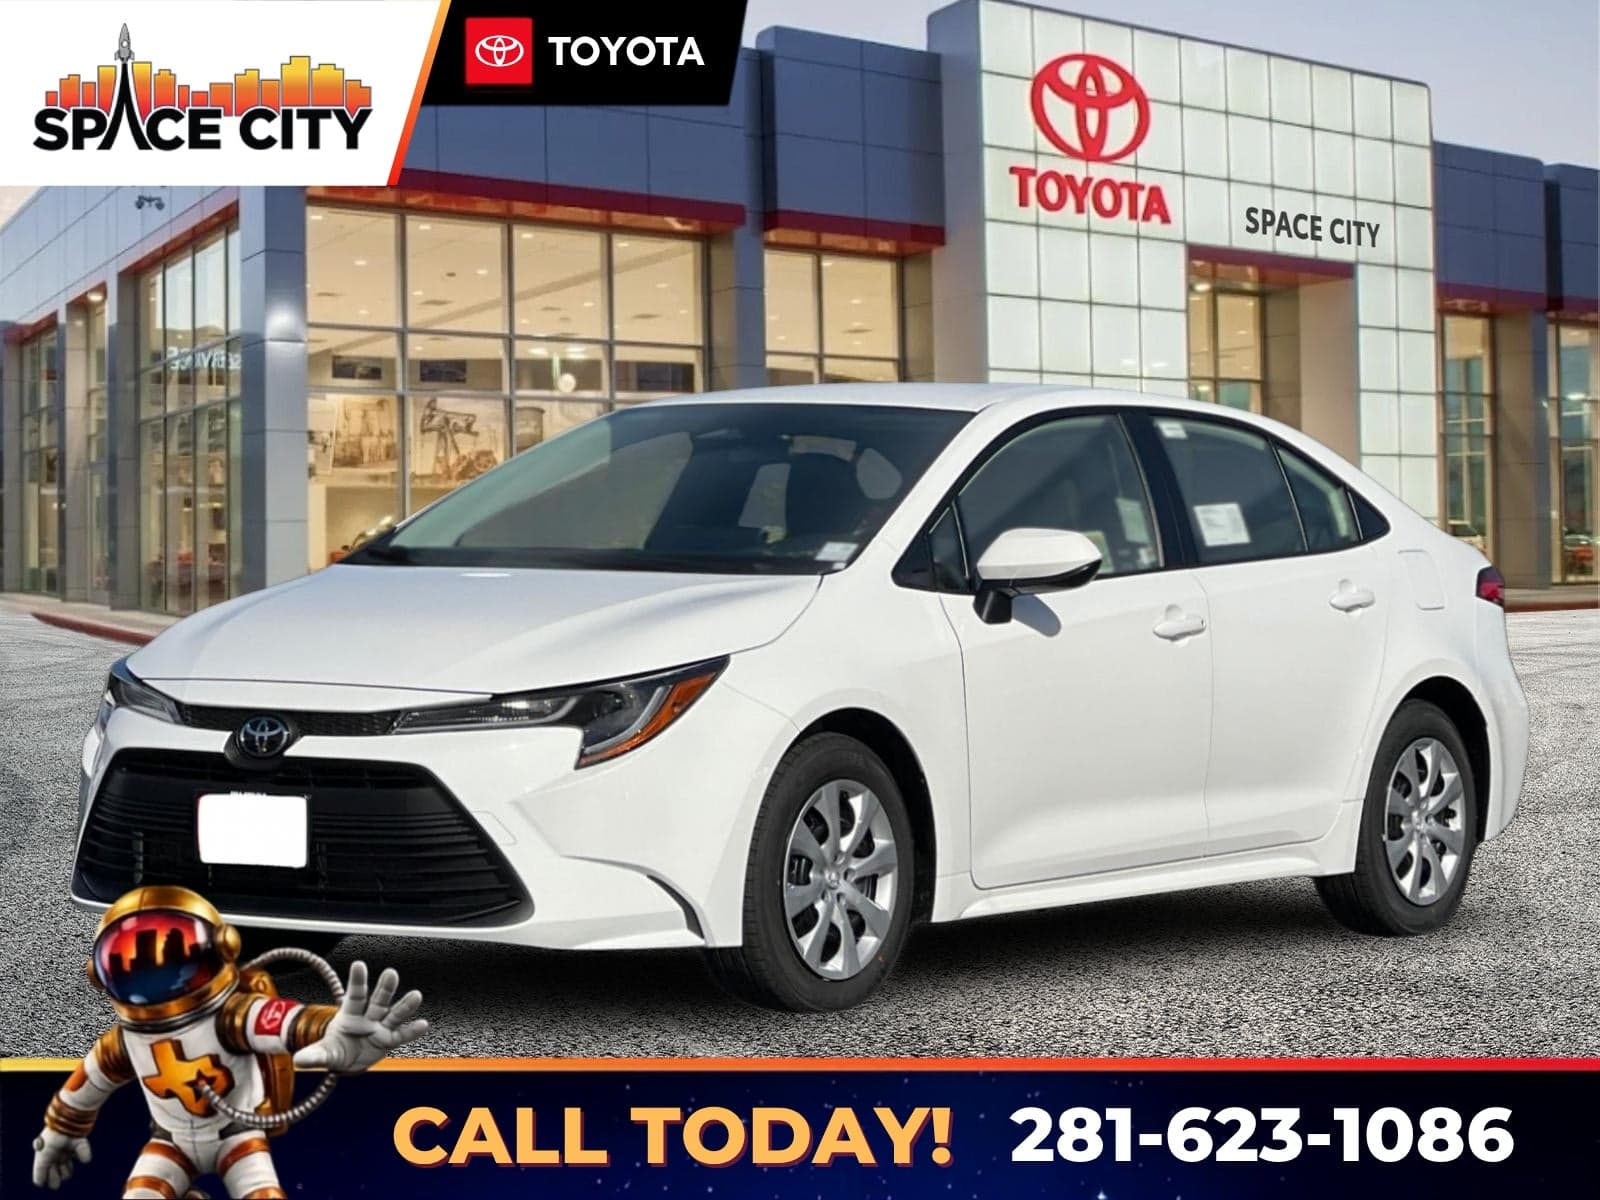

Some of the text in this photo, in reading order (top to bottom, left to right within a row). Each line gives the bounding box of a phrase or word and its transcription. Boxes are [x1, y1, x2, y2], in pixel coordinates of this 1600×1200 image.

[1009, 166, 1171, 224] TOYOTA
[1245, 206, 1381, 248] SPACE CITY
